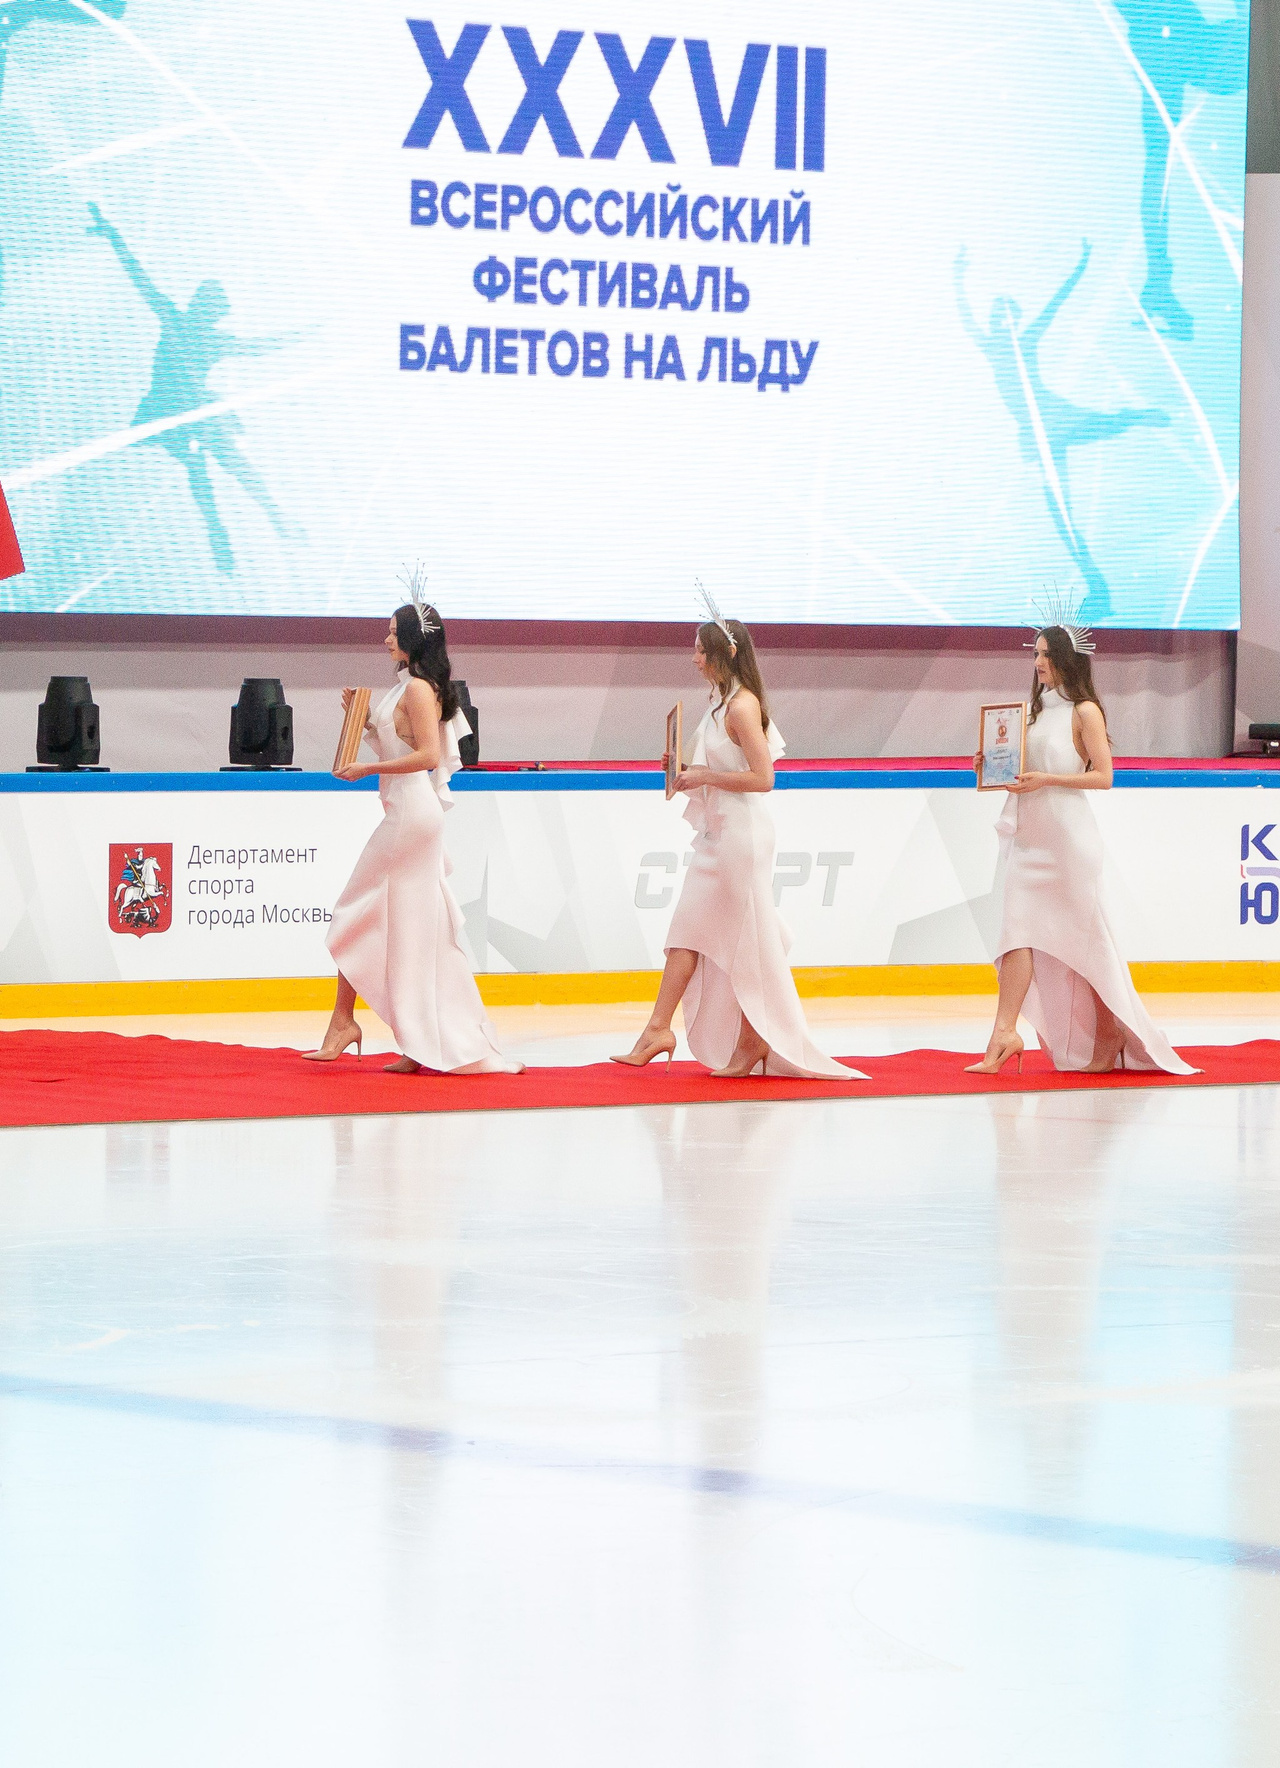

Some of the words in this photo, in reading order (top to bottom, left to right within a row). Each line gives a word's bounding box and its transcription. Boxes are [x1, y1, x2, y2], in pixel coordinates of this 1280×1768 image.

[402, 18, 827, 172] XXXVII
[410, 179, 811, 246] ВСЕРОССИЙСКИЙ
[473, 256, 750, 313] ФЕСТИВАЛЬ
[399, 323, 609, 378] БАЛЕТОВ
[624, 333, 687, 381] НА
[697, 336, 819, 393] ЛЬДУ
[187, 845, 318, 870] Департамент
[634, 851, 855, 909] СРТ
[188, 879, 254, 900] спорта
[188, 908, 255, 931] города
